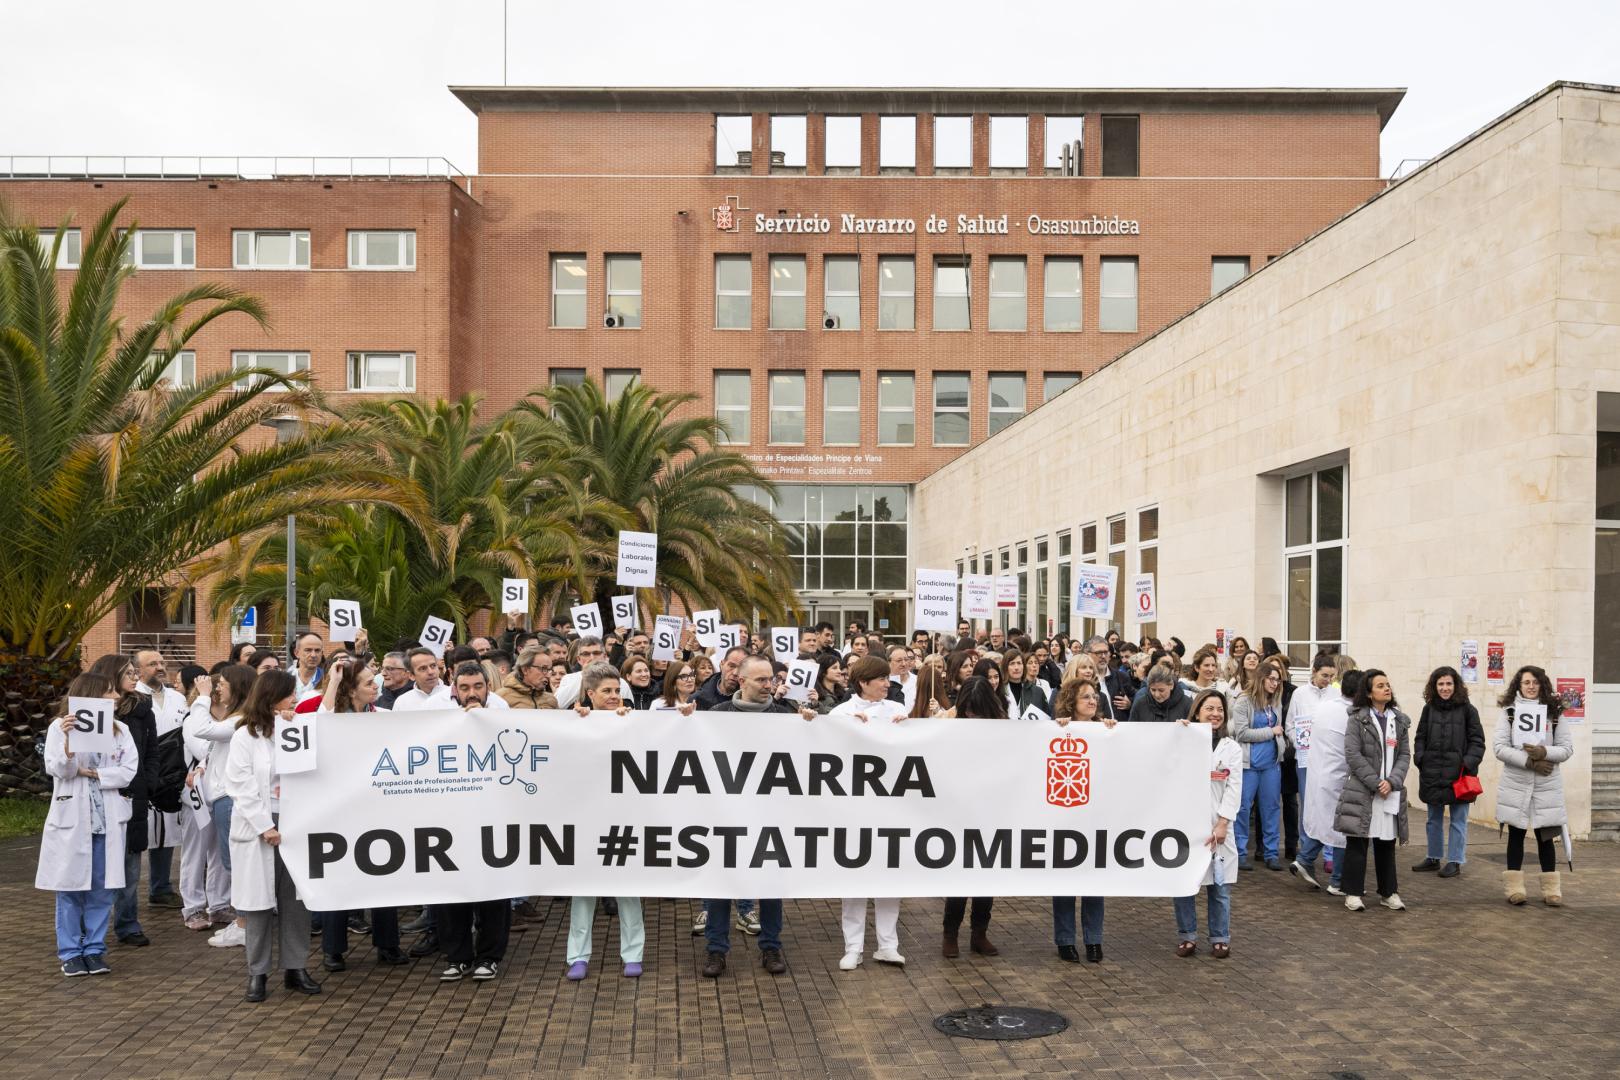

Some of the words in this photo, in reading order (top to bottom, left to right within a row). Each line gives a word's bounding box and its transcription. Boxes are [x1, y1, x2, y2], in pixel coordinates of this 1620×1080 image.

[755, 213, 831, 234] Servicio
[840, 213, 916, 234] Navarro
[925, 214, 948, 234] de
[957, 214, 1008, 235] Salud
[1027, 214, 1140, 236] Osasunbidea
[620, 540, 656, 549] Condiciones
[621, 552, 654, 561] Laborales
[625, 566, 648, 574] Dignas
[916, 579, 956, 588] Condiciones
[505, 587, 523, 601] SI
[918, 594, 954, 602] Laborales
[334, 608, 357, 627] SI
[616, 603, 634, 618] SI
[923, 608, 949, 617] Dignas
[576, 611, 598, 629] SI
[696, 618, 715, 634] SI
[425, 625, 446, 645] SI
[658, 632, 675, 649] SI
[719, 633, 736, 648] SI
[775, 635, 795, 653] SI
[789, 668, 812, 688] SI
[74, 709, 104, 734] SI
[1518, 713, 1542, 733] SI
[281, 725, 309, 752] SI
[372, 779, 413, 788] Agrupación
[424, 776, 471, 785] Profesionales
[471, 776, 483, 784] por
[611, 750, 936, 797] NAVARRA
[190, 785, 203, 810] SI
[383, 787, 413, 795] Estatuto
[446, 784, 483, 793] Facultativo
[308, 826, 460, 879] POR
[481, 824, 575, 868] UN
[597, 825, 1189, 869] #ESTATUTOMEDICO
